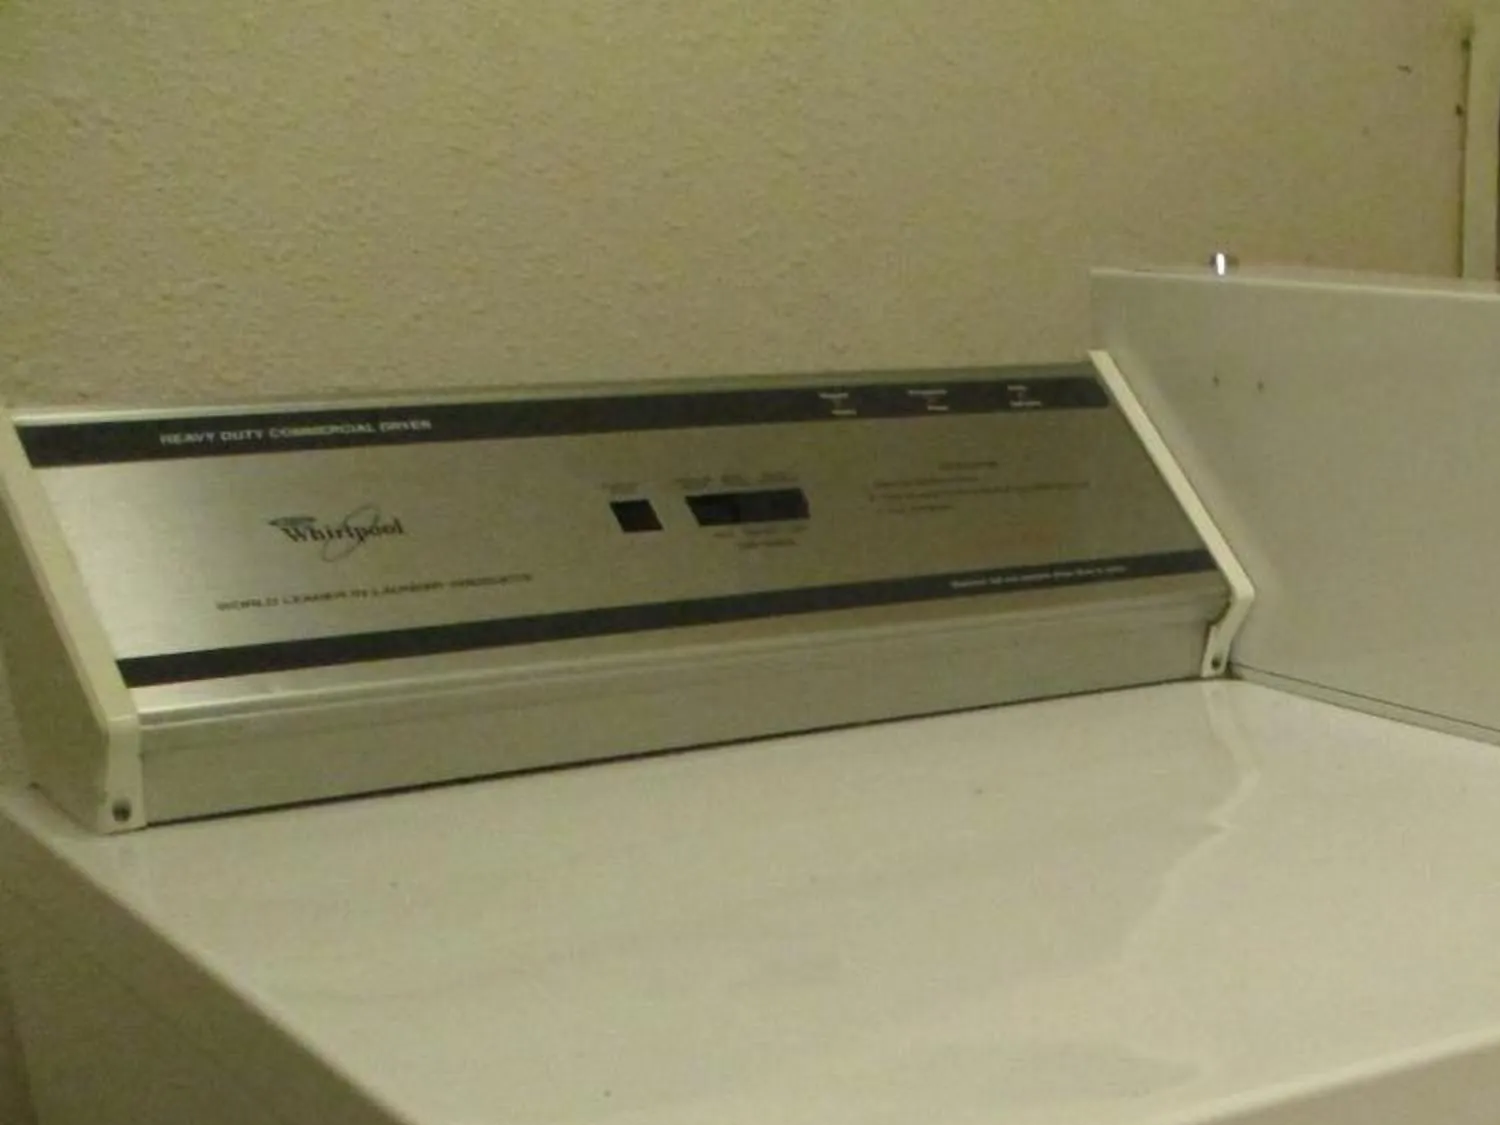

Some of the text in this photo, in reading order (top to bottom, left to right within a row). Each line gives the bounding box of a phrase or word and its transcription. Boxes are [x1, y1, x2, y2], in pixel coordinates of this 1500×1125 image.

[160, 431, 215, 445] HEAVY
[220, 428, 263, 442] DUTY
[268, 422, 377, 440] COMMERCIAL
[269, 514, 405, 544] Whirlpool
